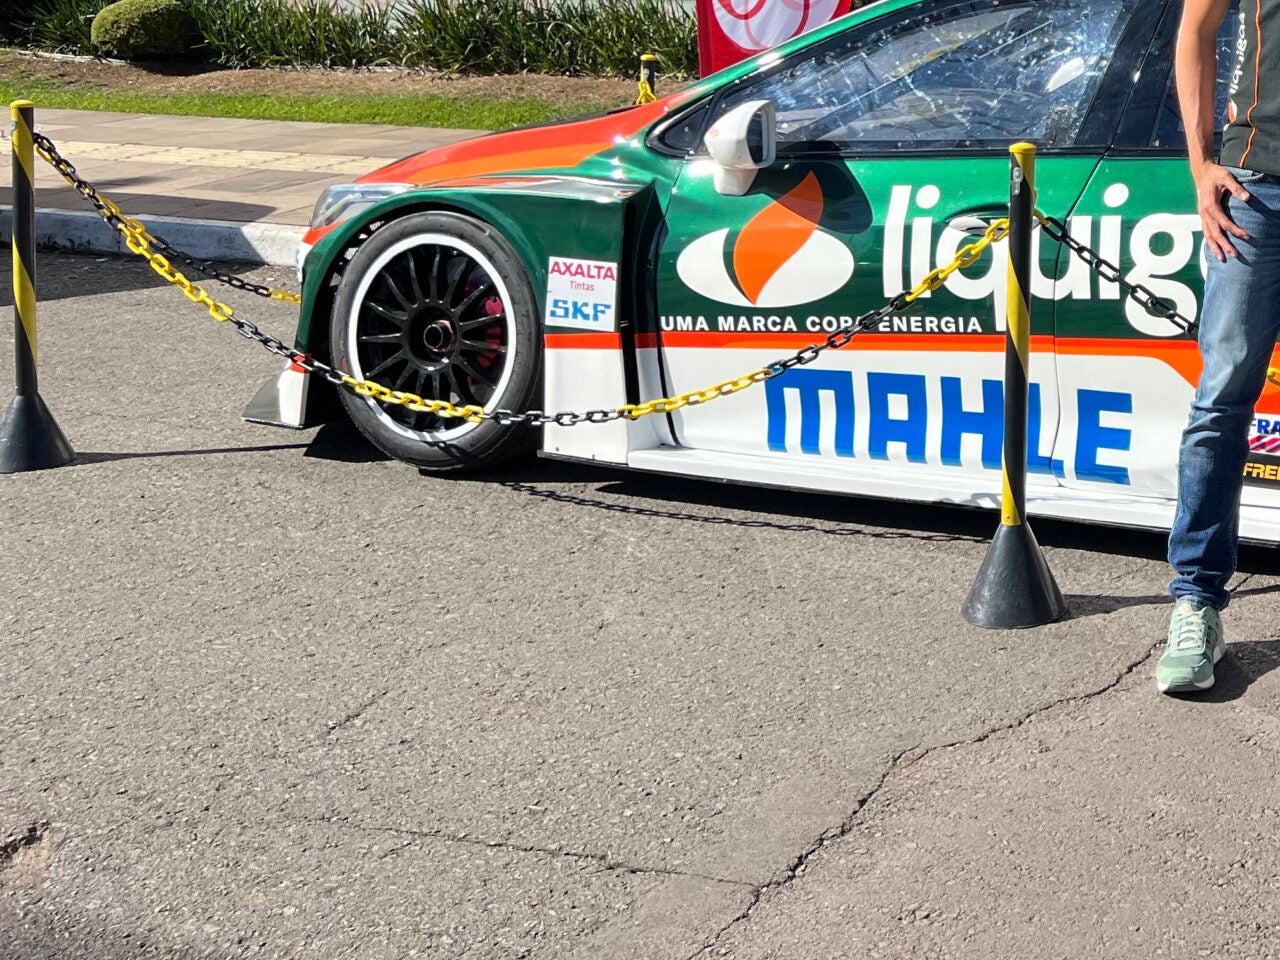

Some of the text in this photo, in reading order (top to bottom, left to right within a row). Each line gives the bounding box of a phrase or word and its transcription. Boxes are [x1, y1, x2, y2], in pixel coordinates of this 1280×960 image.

[550, 261, 616, 281] AXALTA
[569, 280, 595, 292] Tintas
[550, 299, 612, 322] SKF
[661, 316, 709, 331] UMA
[718, 316, 797, 331] MARCA
[878, 316, 982, 333] ENERGIA
[765, 366, 1132, 486] MAHLE
